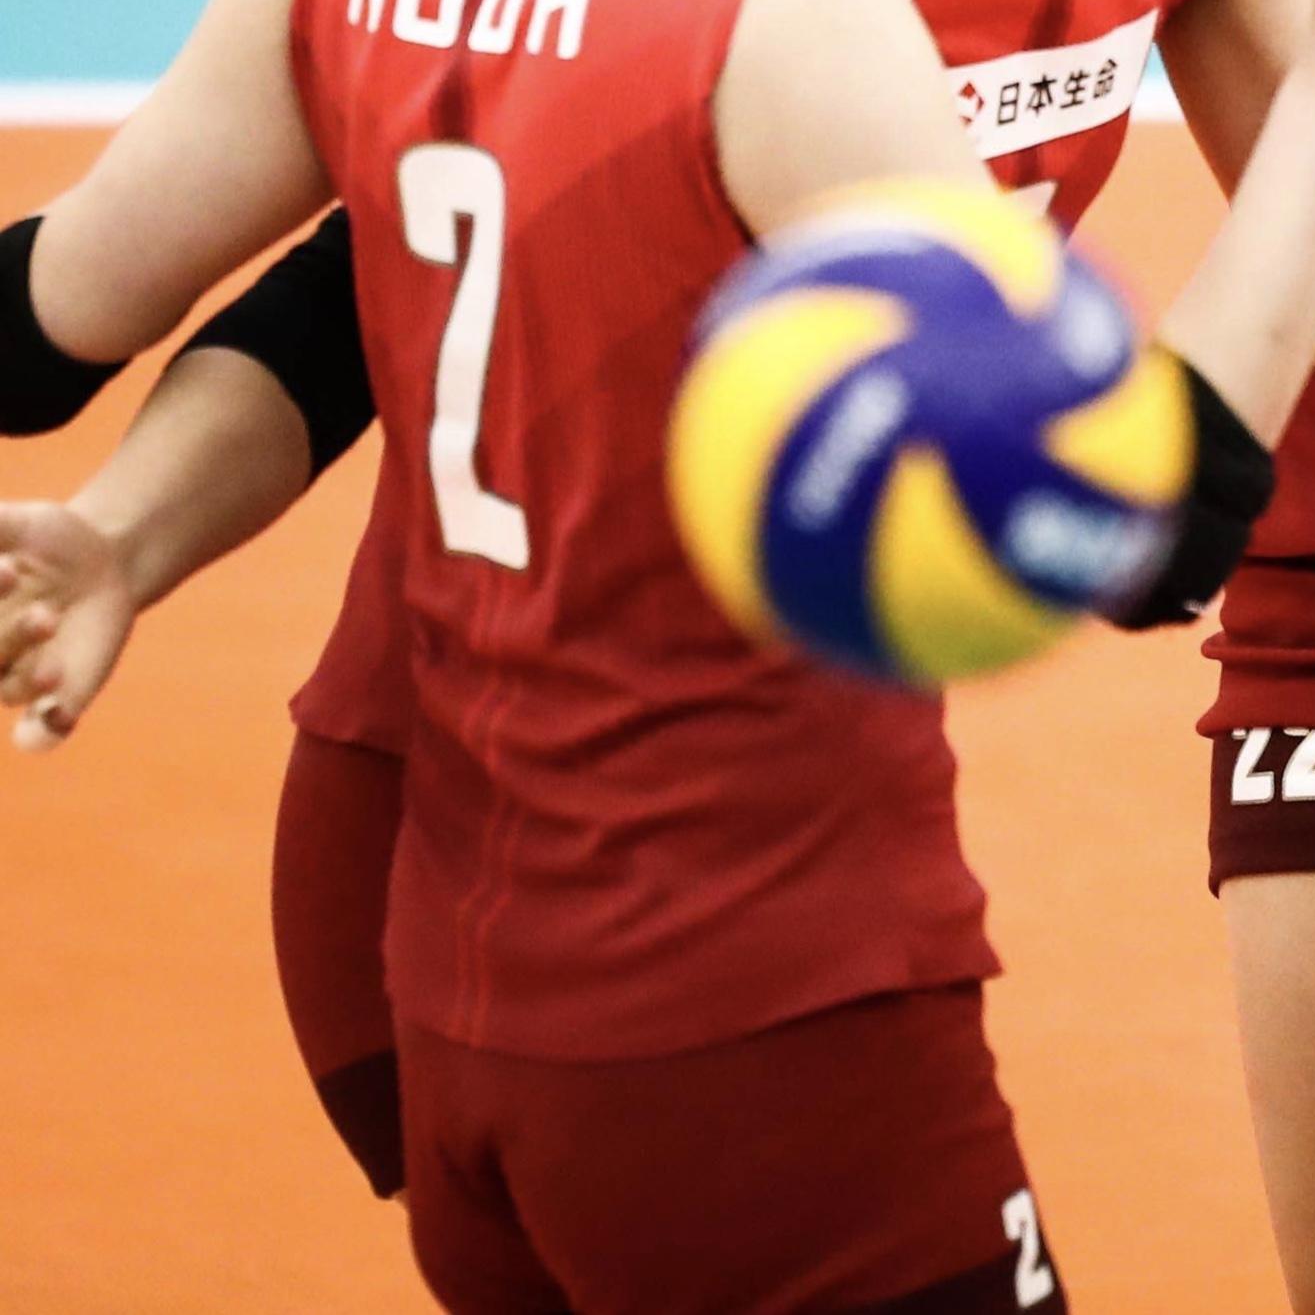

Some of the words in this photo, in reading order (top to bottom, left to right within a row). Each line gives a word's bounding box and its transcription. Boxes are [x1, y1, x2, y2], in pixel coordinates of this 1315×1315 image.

[997, 58, 1118, 126] 日本生命
[397, 142, 530, 570] 2
[1002, 1188, 1054, 1308] 2
